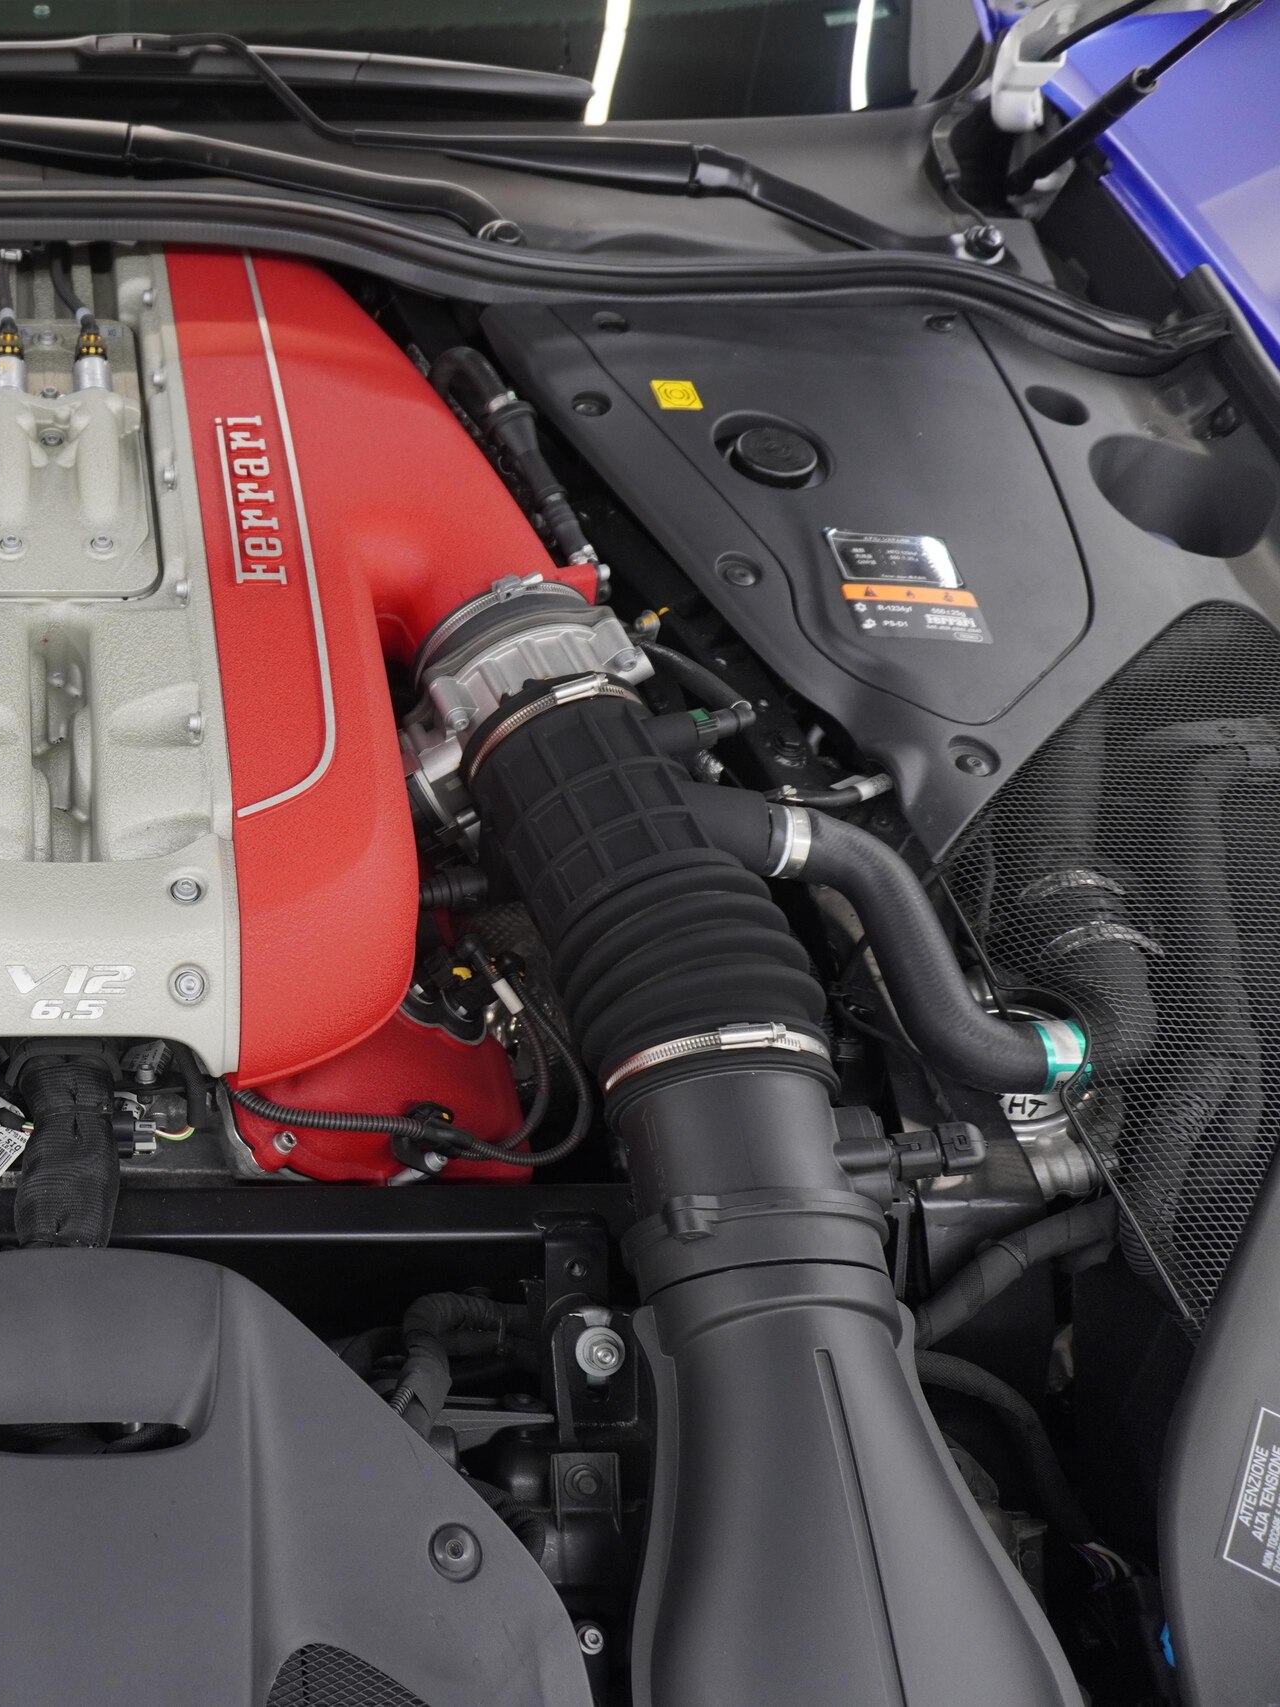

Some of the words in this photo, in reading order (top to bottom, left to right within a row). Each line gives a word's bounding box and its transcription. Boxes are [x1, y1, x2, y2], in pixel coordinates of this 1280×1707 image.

[214, 415, 288, 586] Ferrari
[5, 964, 136, 994] V12
[30, 999, 108, 1020] 6.5
[1238, 1445, 1269, 1528] ATTENZIONE
[1251, 1511, 1270, 1542] ALTA
